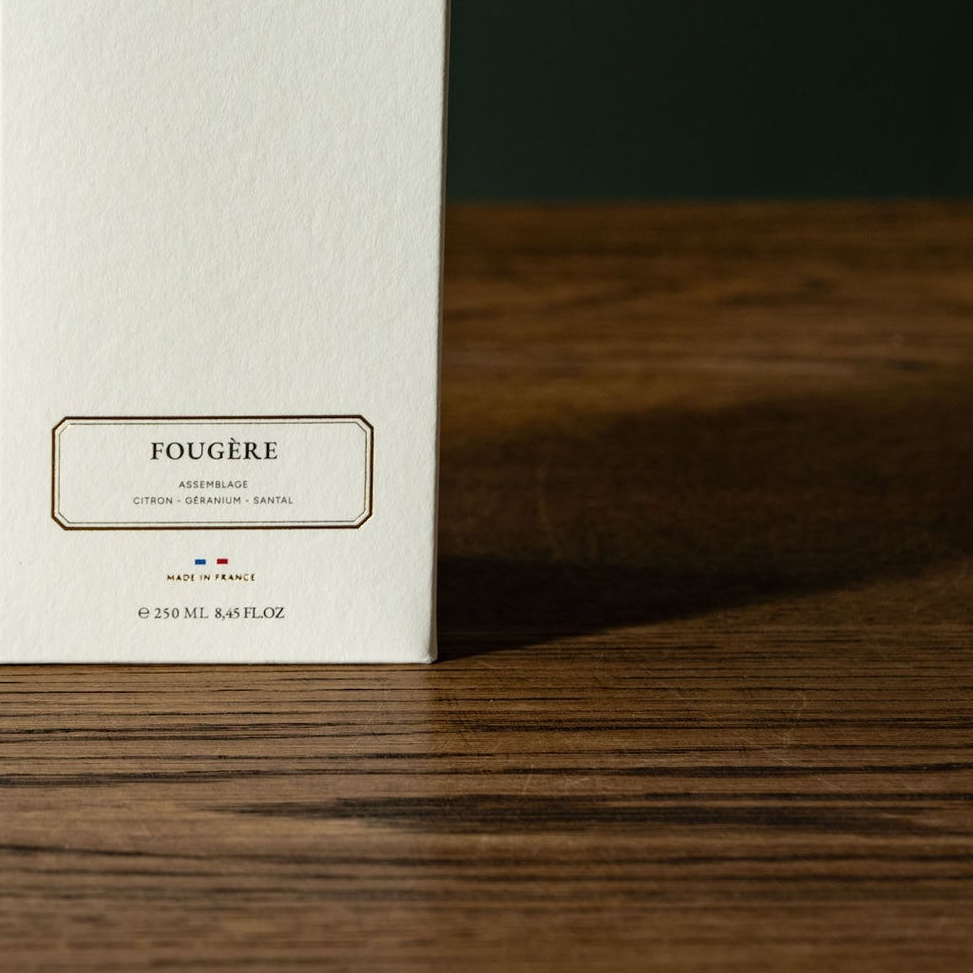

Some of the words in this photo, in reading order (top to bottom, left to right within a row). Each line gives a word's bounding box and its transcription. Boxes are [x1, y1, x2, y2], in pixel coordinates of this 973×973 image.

[150, 438, 278, 460] FOUGÈRE
[133, 497, 173, 505] CITRON
[185, 495, 241, 505] GÉRANIUM
[154, 608, 180, 619] 250
[184, 608, 209, 618] ML
